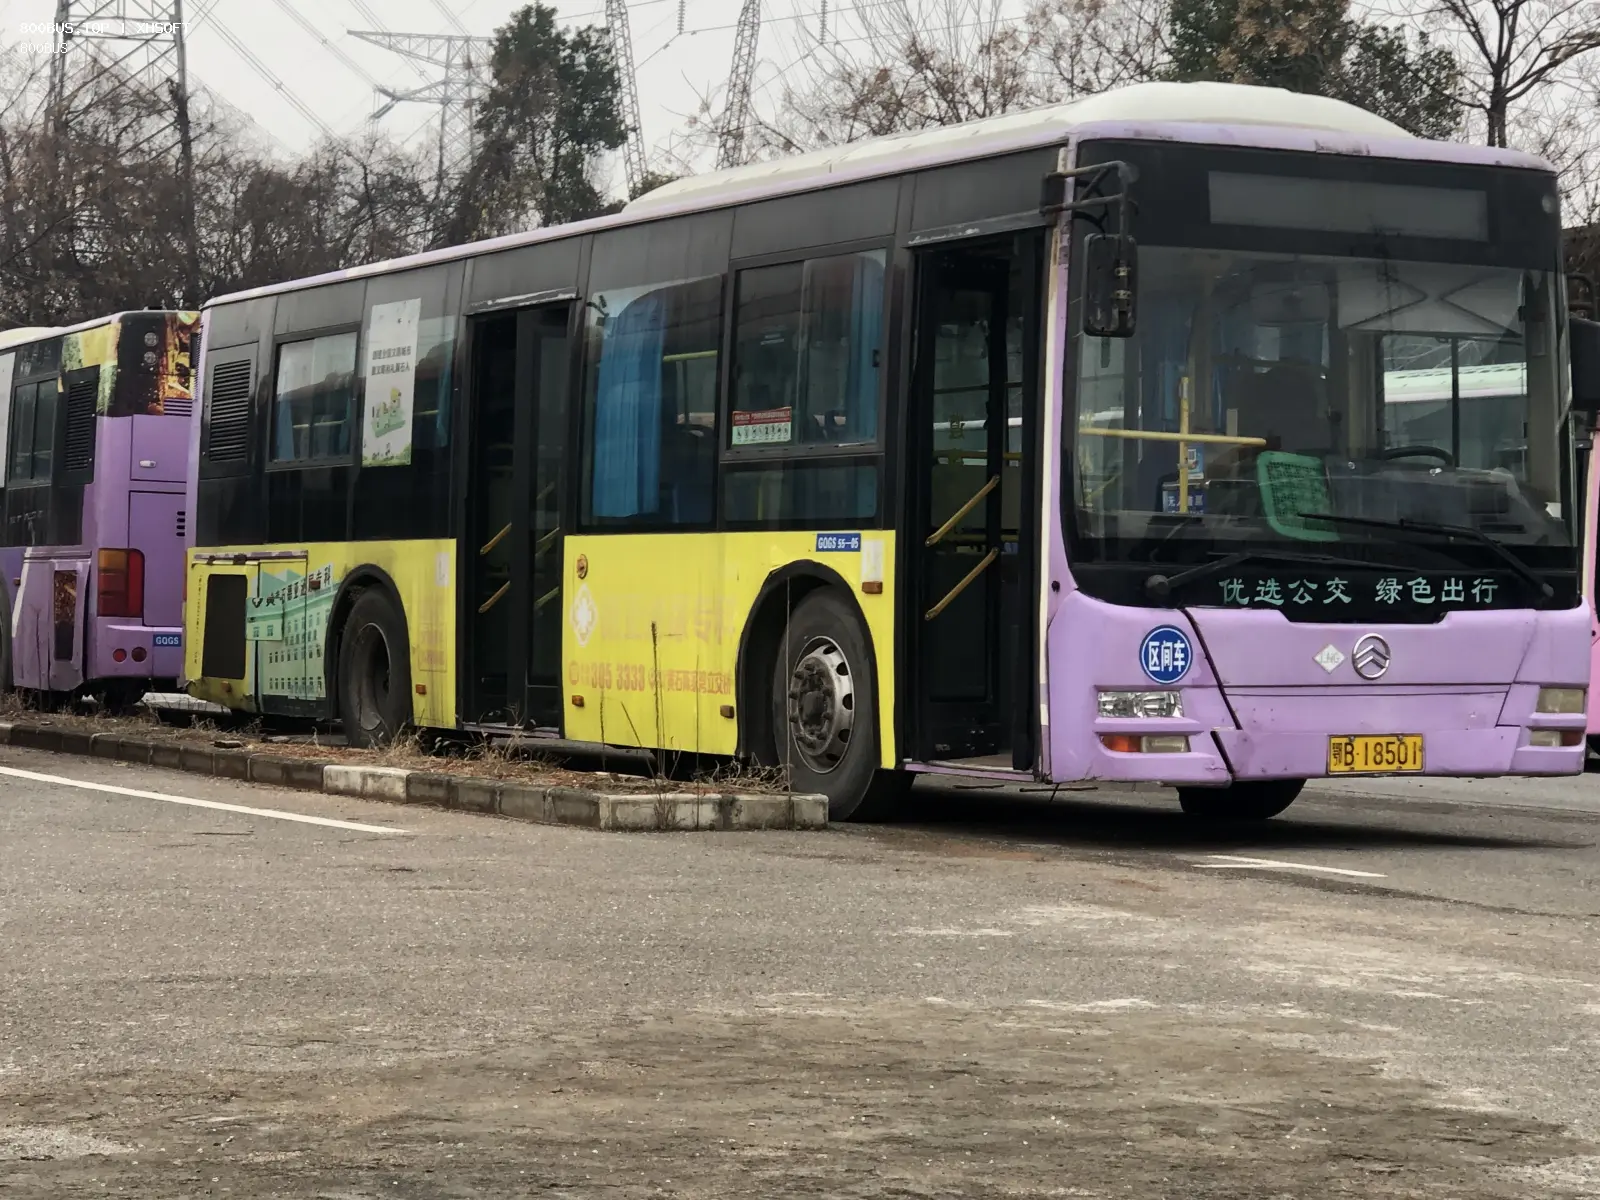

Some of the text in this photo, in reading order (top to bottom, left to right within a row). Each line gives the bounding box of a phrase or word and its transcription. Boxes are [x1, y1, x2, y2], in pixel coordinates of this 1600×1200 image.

[1218, 577, 1498, 606] 优选公交 绿色出行
[1148, 639, 1186, 672] 区间车
